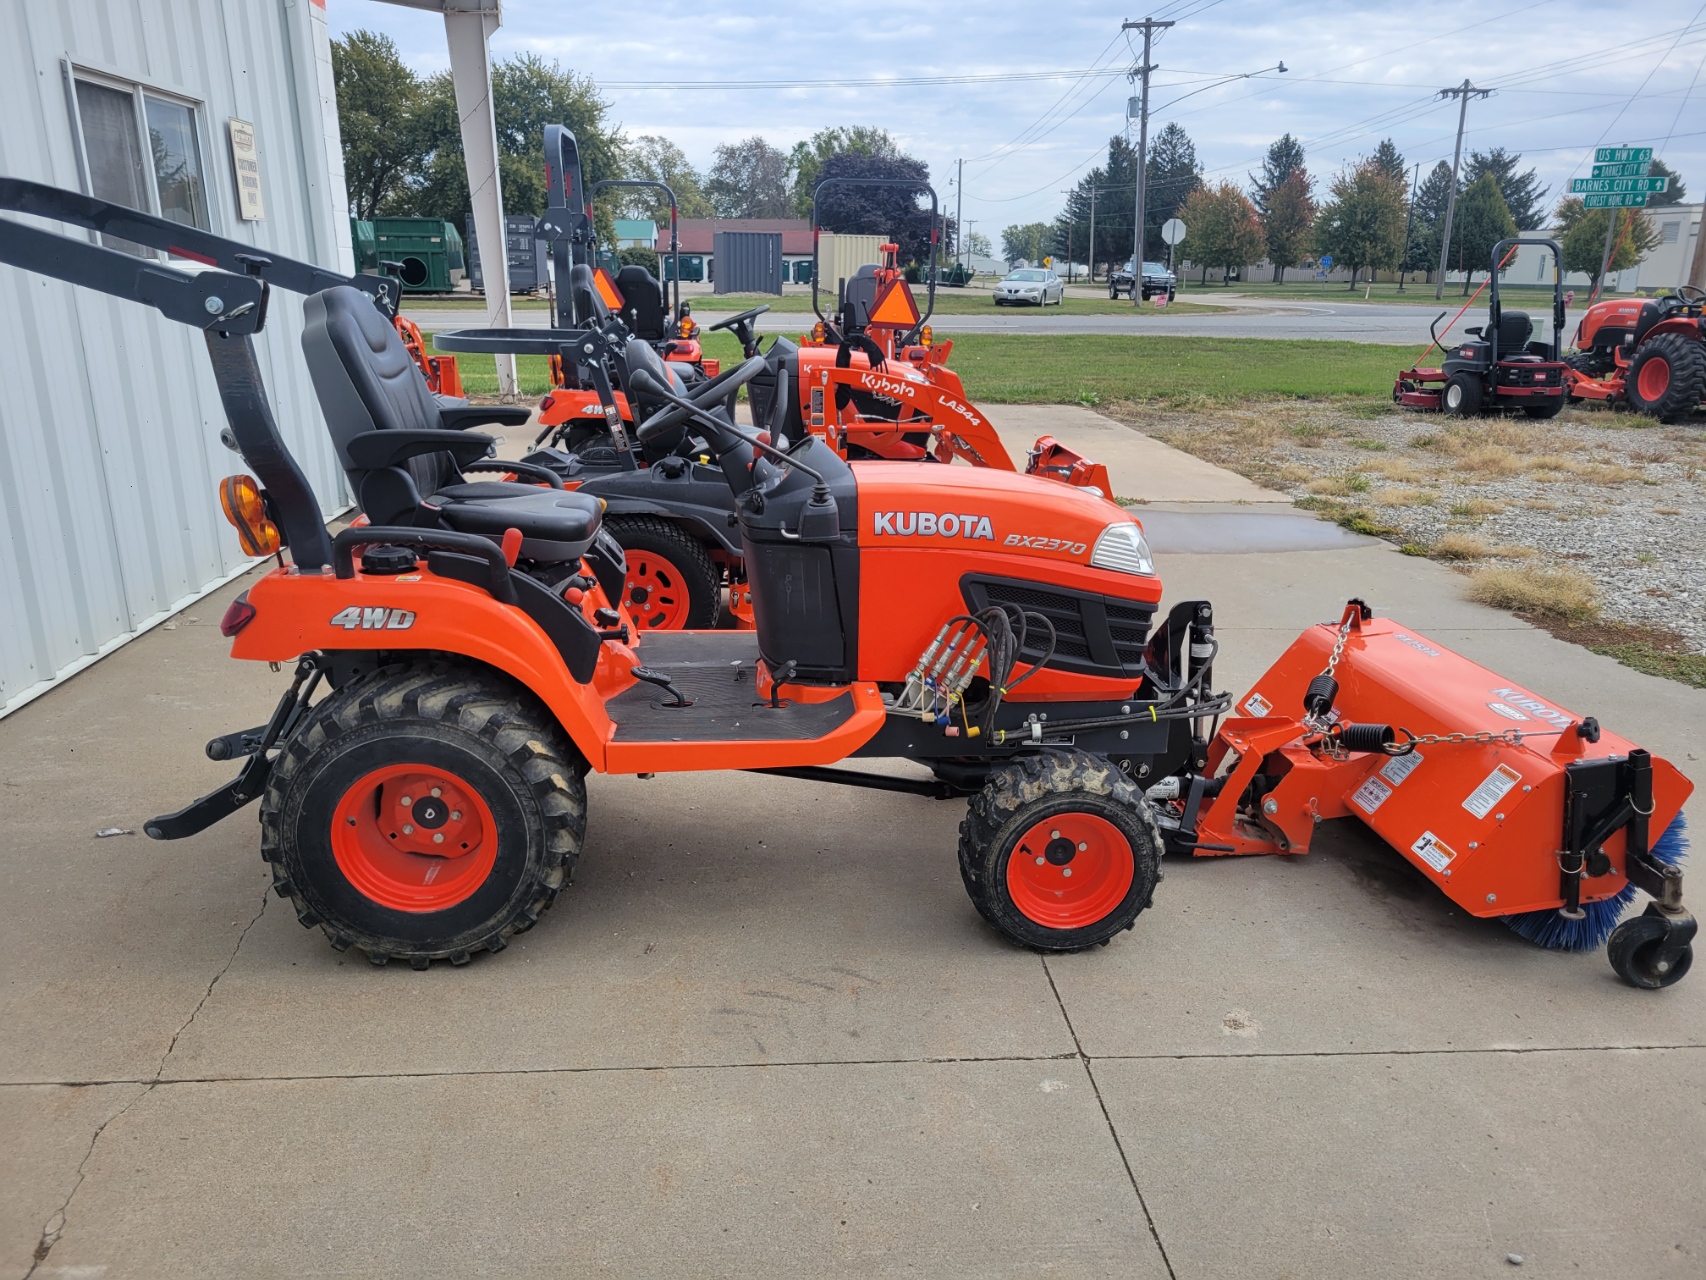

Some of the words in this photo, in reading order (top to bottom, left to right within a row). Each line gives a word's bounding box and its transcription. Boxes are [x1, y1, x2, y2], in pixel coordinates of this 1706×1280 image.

[1599, 150, 1611, 161] US
[1615, 150, 1635, 160] HWY
[1639, 149, 1650, 160] 63
[1601, 165, 1623, 177] BARNES
[1624, 163, 1638, 176] CITY
[1639, 162, 1649, 175] RD
[1575, 180, 1609, 191] BARNES
[1613, 180, 1634, 191] CITY
[1637, 179, 1649, 190] RD
[1586, 196, 1606, 207] FOREST
[1607, 195, 1623, 206] HOME
[1625, 195, 1634, 206] RD
[861, 373, 915, 397] Kubota
[938, 395, 981, 427] LA344
[873, 511, 996, 541] KUBOTA
[1003, 534, 1087, 555] BX2370
[329, 606, 416, 630] 4WD
